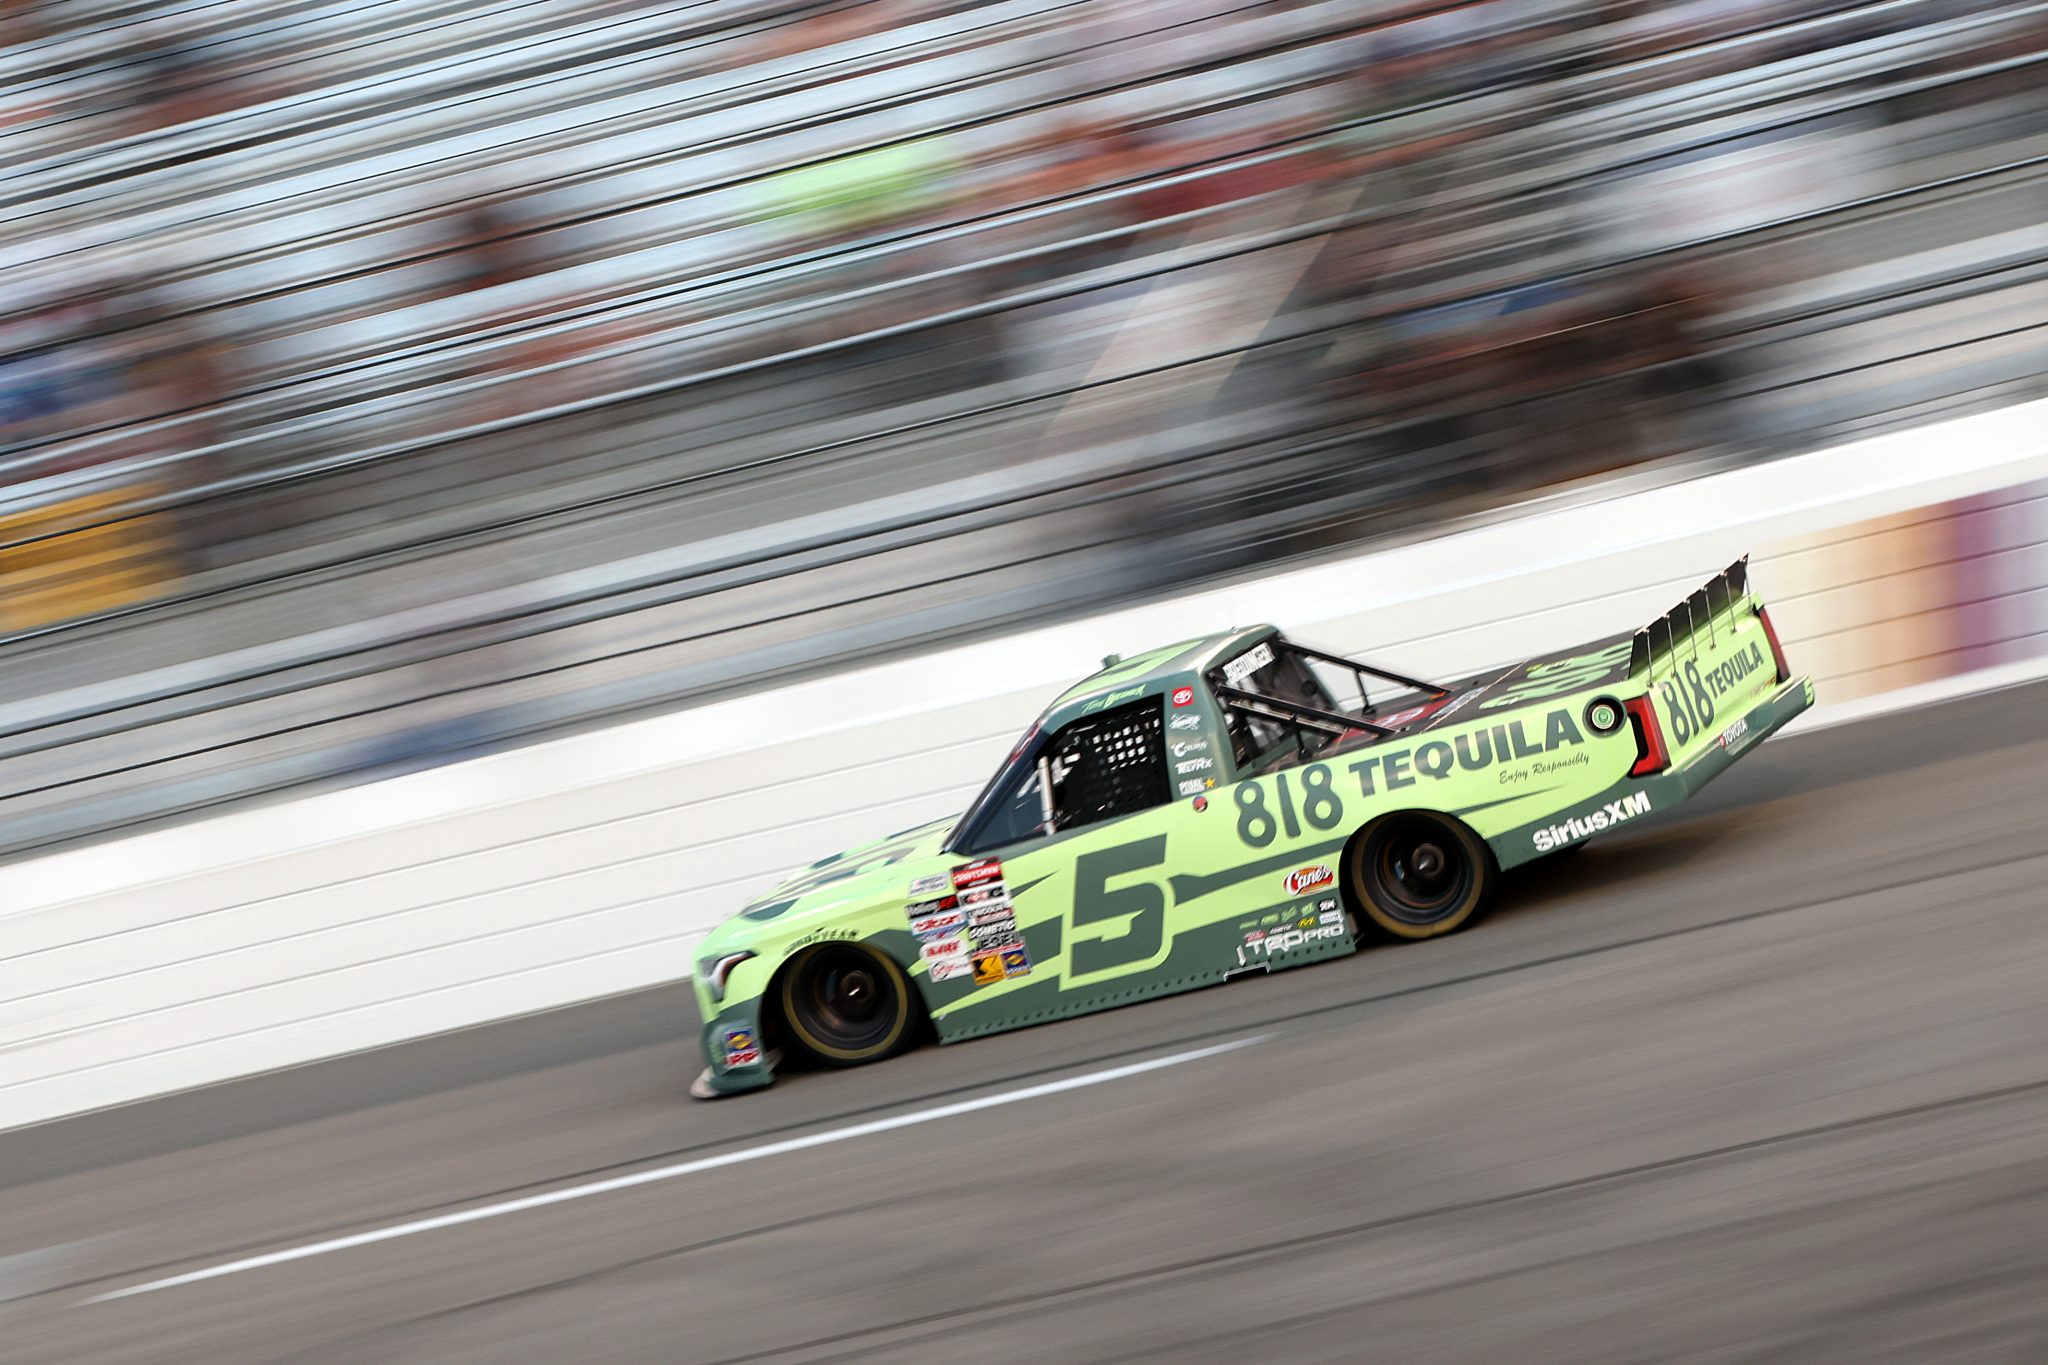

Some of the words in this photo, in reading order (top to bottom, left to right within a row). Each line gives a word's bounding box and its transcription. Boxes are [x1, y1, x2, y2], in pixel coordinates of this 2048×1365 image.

[1662, 660, 1714, 747] 818
[1704, 641, 1764, 700] TEQUILA
[1723, 718, 1749, 745] TOYOTA
[1233, 763, 1343, 848] 818
[1349, 709, 1585, 798] TEQUILA
[1499, 768, 1528, 785] Enjoy
[1532, 752, 1590, 776] Responsibly
[1532, 790, 1652, 852] SiriusXM
[1070, 833, 1168, 978] 5
